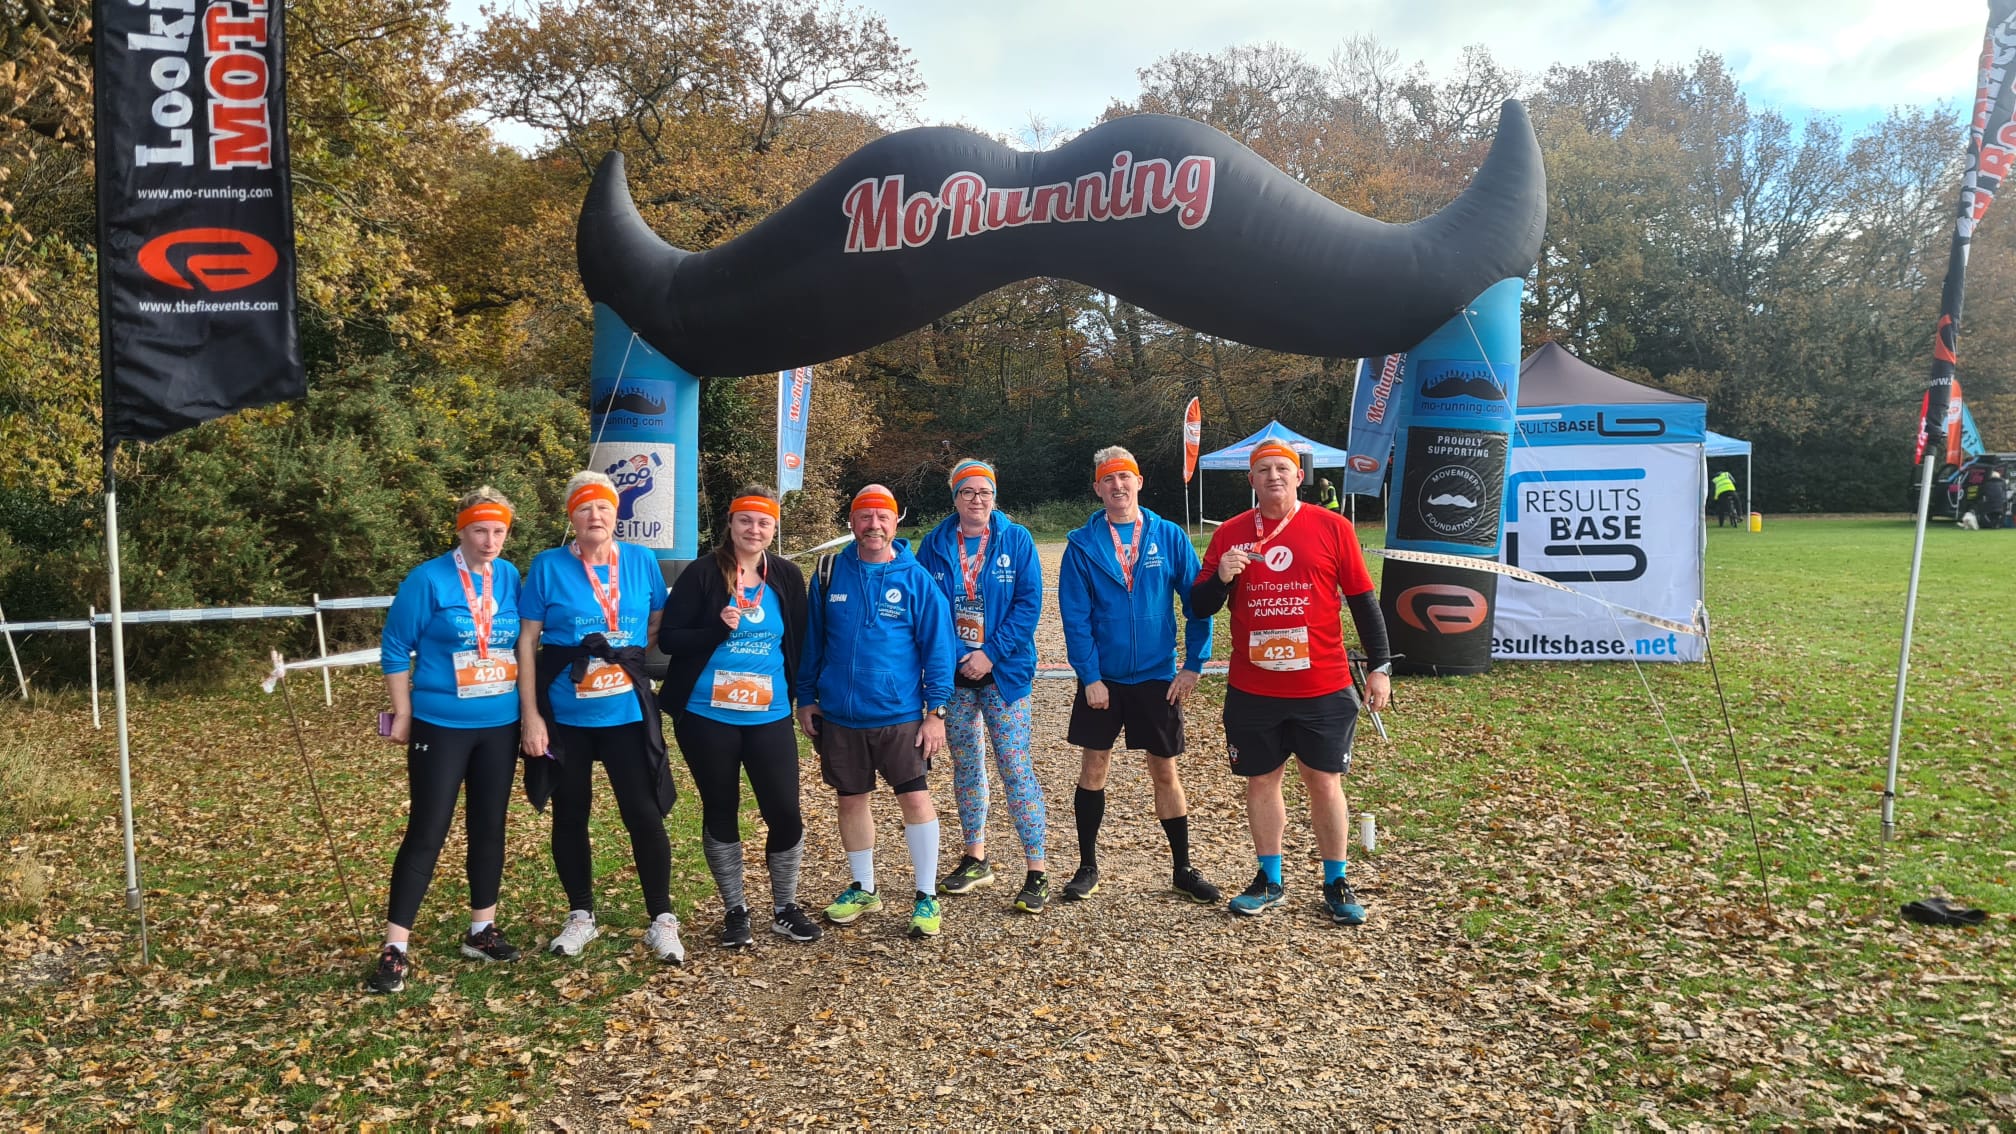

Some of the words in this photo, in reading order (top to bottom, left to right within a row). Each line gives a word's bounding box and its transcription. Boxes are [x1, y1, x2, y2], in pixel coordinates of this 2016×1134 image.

[202, 0, 272, 170] MOT
[137, 187, 273, 201] www.mo-running.com
[842, 150, 1215, 253] MoRunning
[139, 300, 279, 313] www.thefixevents.com
[1421, 401, 1505, 414] mo-running.com
[605, 415, 663, 427] unning.com
[1515, 420, 1595, 434] ESULTSBASE
[1437, 435, 1483, 447] PROUDLY
[1427, 446, 1489, 458] SUPPORTING
[615, 467, 651, 486] ZOO
[1432, 469, 1479, 489] MOVEMBER
[1526, 488, 1641, 513] RESULTS
[1425, 512, 1476, 532] FOUNDATION
[1550, 515, 1641, 541] BASE
[1246, 581, 1313, 592] RunTogether
[1247, 597, 1311, 607] WATERSIDE
[1254, 606, 1305, 617] RUNNERS
[1491, 633, 1677, 655] esultsbase.net
[1264, 646, 1296, 660] 423
[475, 667, 506, 682] 420
[592, 671, 625, 689] 422
[728, 689, 757, 704] 421
